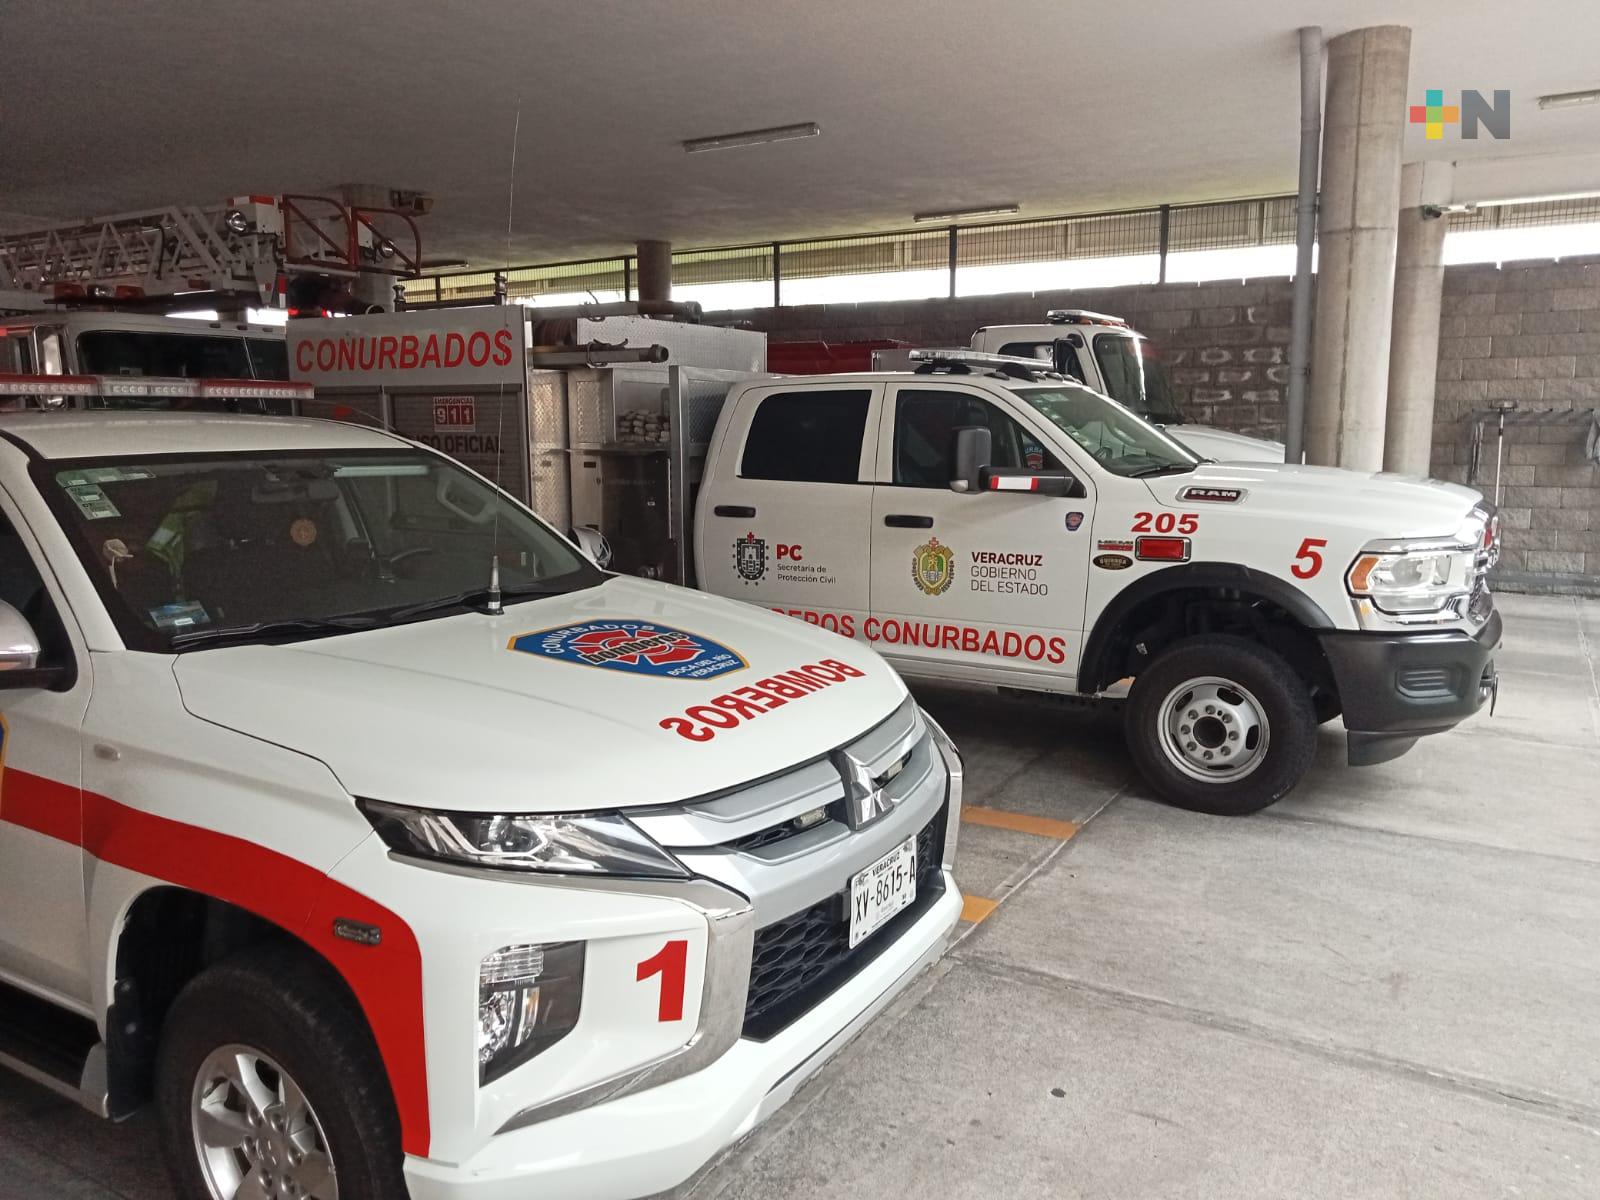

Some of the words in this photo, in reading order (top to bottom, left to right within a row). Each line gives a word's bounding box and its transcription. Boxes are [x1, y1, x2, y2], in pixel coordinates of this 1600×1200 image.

[296, 329, 513, 373] CONURBADOS
[436, 407, 471, 423] 911
[444, 434, 504, 454] OFICIAL
[1191, 489, 1237, 498] RAM
[1131, 512, 1200, 534] 205
[776, 543, 803, 561] PC
[971, 551, 1043, 567] VERACRUZ
[1291, 538, 1328, 579] 5
[816, 565, 827, 573] de
[970, 565, 1037, 581] GOBIERNO
[819, 575, 837, 585] Civil
[970, 579, 995, 593] DEL
[997, 581, 1048, 596] ESTADO
[541, 624, 655, 654] CONURBADOS
[580, 631, 688, 664] bomberos
[863, 617, 1066, 664] CONURBADOS
[667, 664, 699, 676] BOCA
[688, 659, 740, 677] VERACRUZ
[872, 851, 900, 876] VERACRUZ
[856, 855, 916, 924] XV-8615-A
[636, 940, 688, 1022] 1
